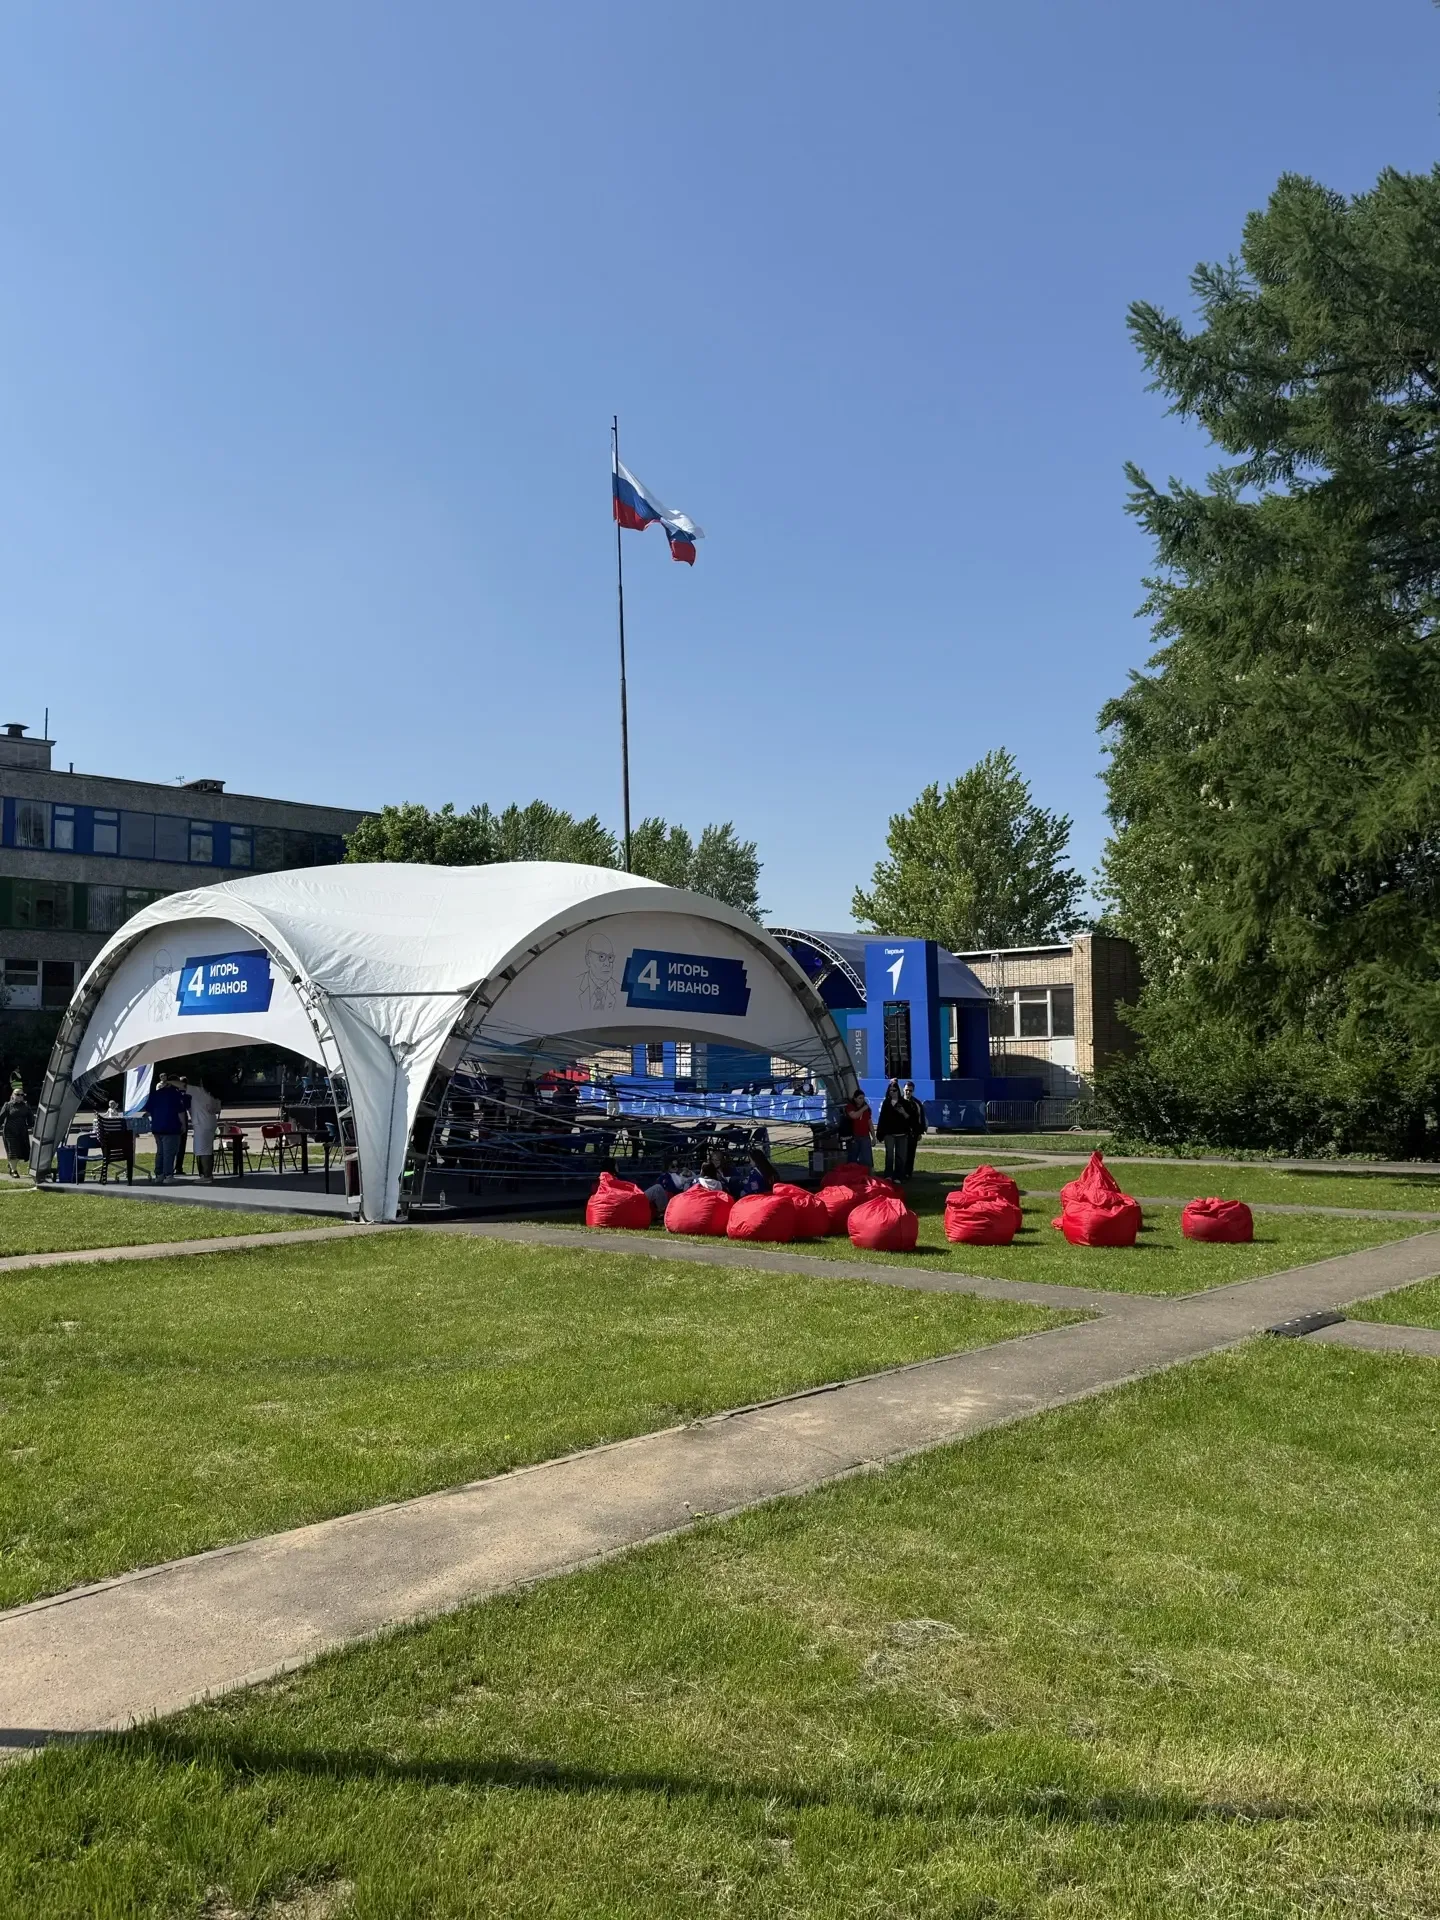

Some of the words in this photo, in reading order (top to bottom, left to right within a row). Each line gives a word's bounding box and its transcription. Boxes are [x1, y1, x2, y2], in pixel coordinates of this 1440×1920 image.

[209, 963, 239, 978] ИГОРЬ
[637, 960, 660, 991] 4
[668, 962, 709, 977] ИГОРЬ
[187, 965, 205, 998] 4
[208, 980, 248, 996] ИВАНОВ
[667, 980, 720, 996] ИВАНОВ
